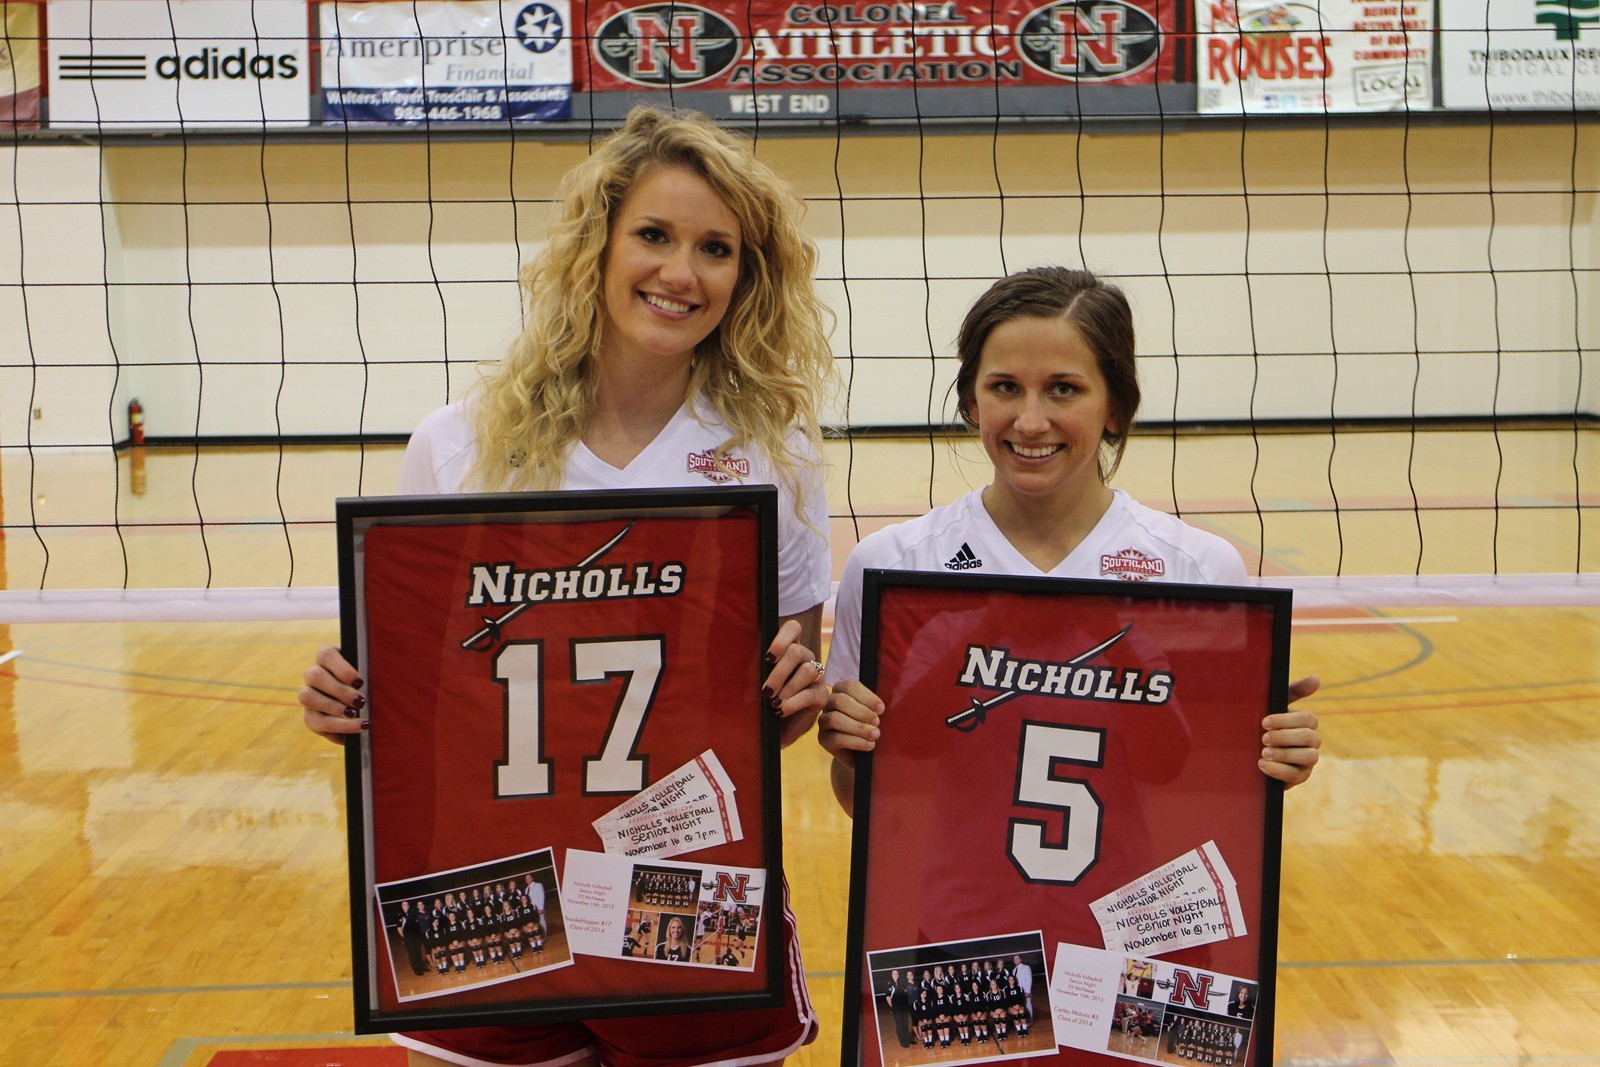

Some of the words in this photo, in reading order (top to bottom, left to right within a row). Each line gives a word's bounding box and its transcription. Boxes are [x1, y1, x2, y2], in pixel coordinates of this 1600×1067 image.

[786, 4, 968, 25] COLONEL
[326, 32, 502, 64] Ameriprise
[741, 25, 1010, 60] ATHLETIC
[1469, 48, 1570, 61] THIBODAUX
[156, 48, 298, 80] adidas
[445, 62, 534, 81] Financial
[728, 60, 1024, 84] ASSOCIATION
[1208, 36, 1333, 85] ROUSES
[1467, 62, 1567, 77] MEDICAL
[485, 90, 497, 102] &
[729, 94, 783, 114] WEST
[789, 94, 830, 113] END
[944, 557, 983, 571] adidas
[1102, 556, 1164, 574] SOUTHLAND
[467, 563, 685, 606] NICHOLLS
[958, 645, 1174, 704] NICHOLLS
[493, 636, 665, 799] 17
[650, 773, 695, 803] VOLLEYBALL
[659, 787, 687, 809] NIGHT
[1008, 721, 1105, 884] 5
[618, 819, 663, 840] NICHOLLS
[665, 806, 714, 823] VOLLEYBALL
[671, 817, 702, 833] NIGHT
[671, 838, 680, 846] 16
[1107, 888, 1147, 914] NICHOLLS
[1148, 863, 1198, 891] VOLLEYBALL
[1158, 877, 1185, 898] NIGHT
[1116, 909, 1167, 931] NICHOLLS
[1169, 898, 1224, 916] VOLLEYBALL
[1124, 931, 1177, 952] November
[1181, 927, 1191, 937] 16
[1193, 925, 1203, 935] @
[1078, 1018, 1093, 1026] 2014
